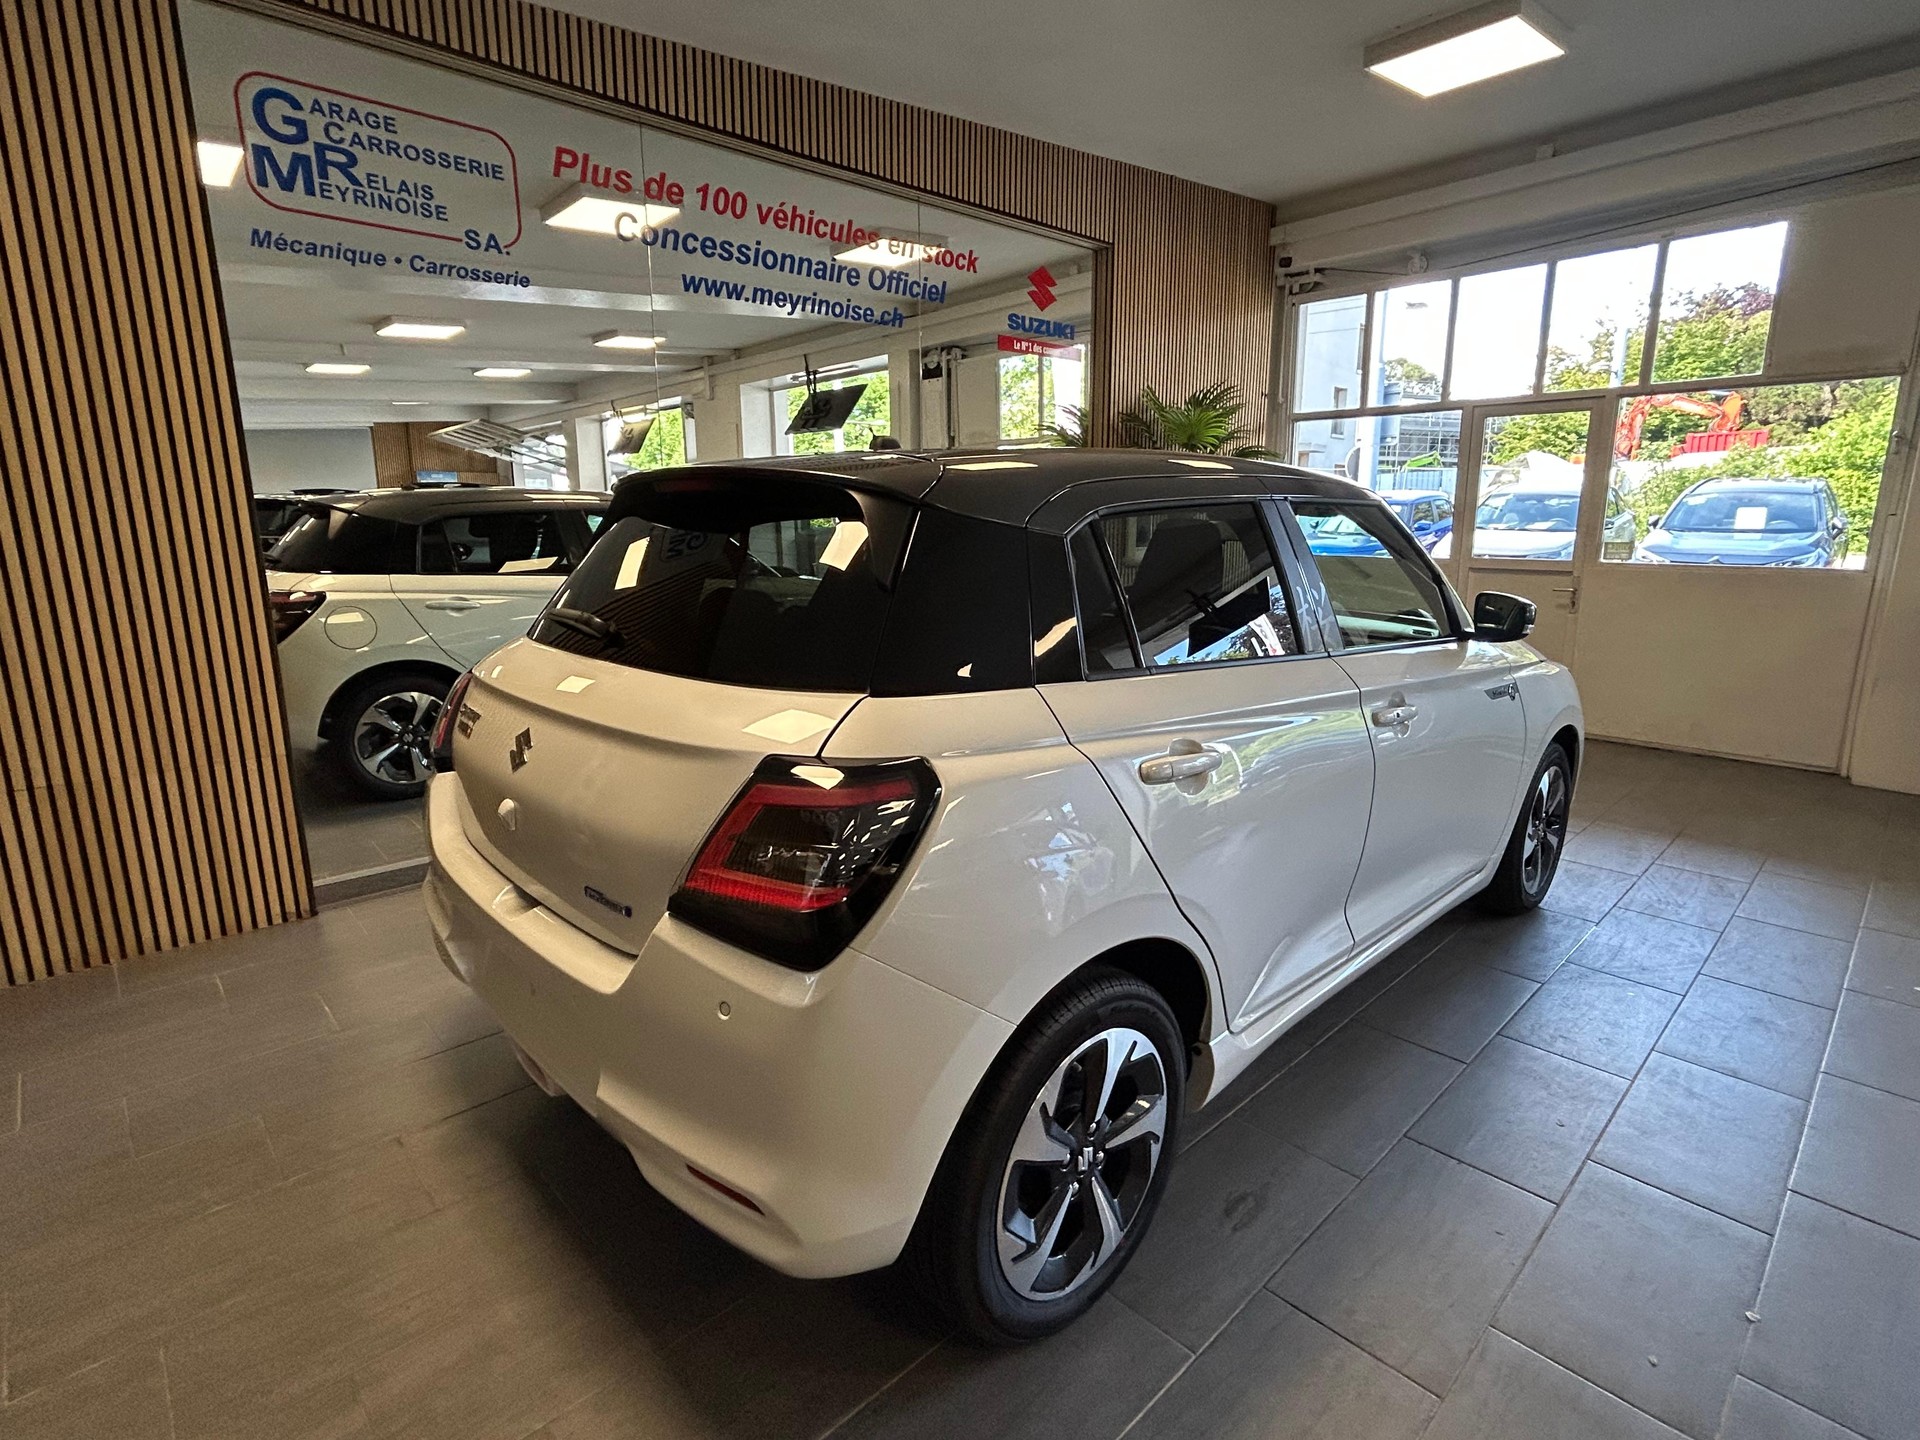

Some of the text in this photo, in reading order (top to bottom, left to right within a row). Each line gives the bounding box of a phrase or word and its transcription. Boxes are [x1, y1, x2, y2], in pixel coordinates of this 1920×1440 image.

[251, 87, 398, 145] GARAGE
[313, 141, 435, 201] RELAIS
[323, 121, 505, 181] CARROSSERIE
[251, 143, 448, 222] MEYRINOISE
[552, 146, 979, 274] Plus de 100 véhicules en stock
[250, 228, 531, 289] Mécanique Carrosserie
[614, 211, 947, 304] Concessionnaire Officiel
[681, 273, 905, 329] www.meyrinoise.ch
[1007, 313, 1076, 340] SUZUKI
[1013, 340, 1020, 350] Le
[1033, 344, 1043, 353] des
